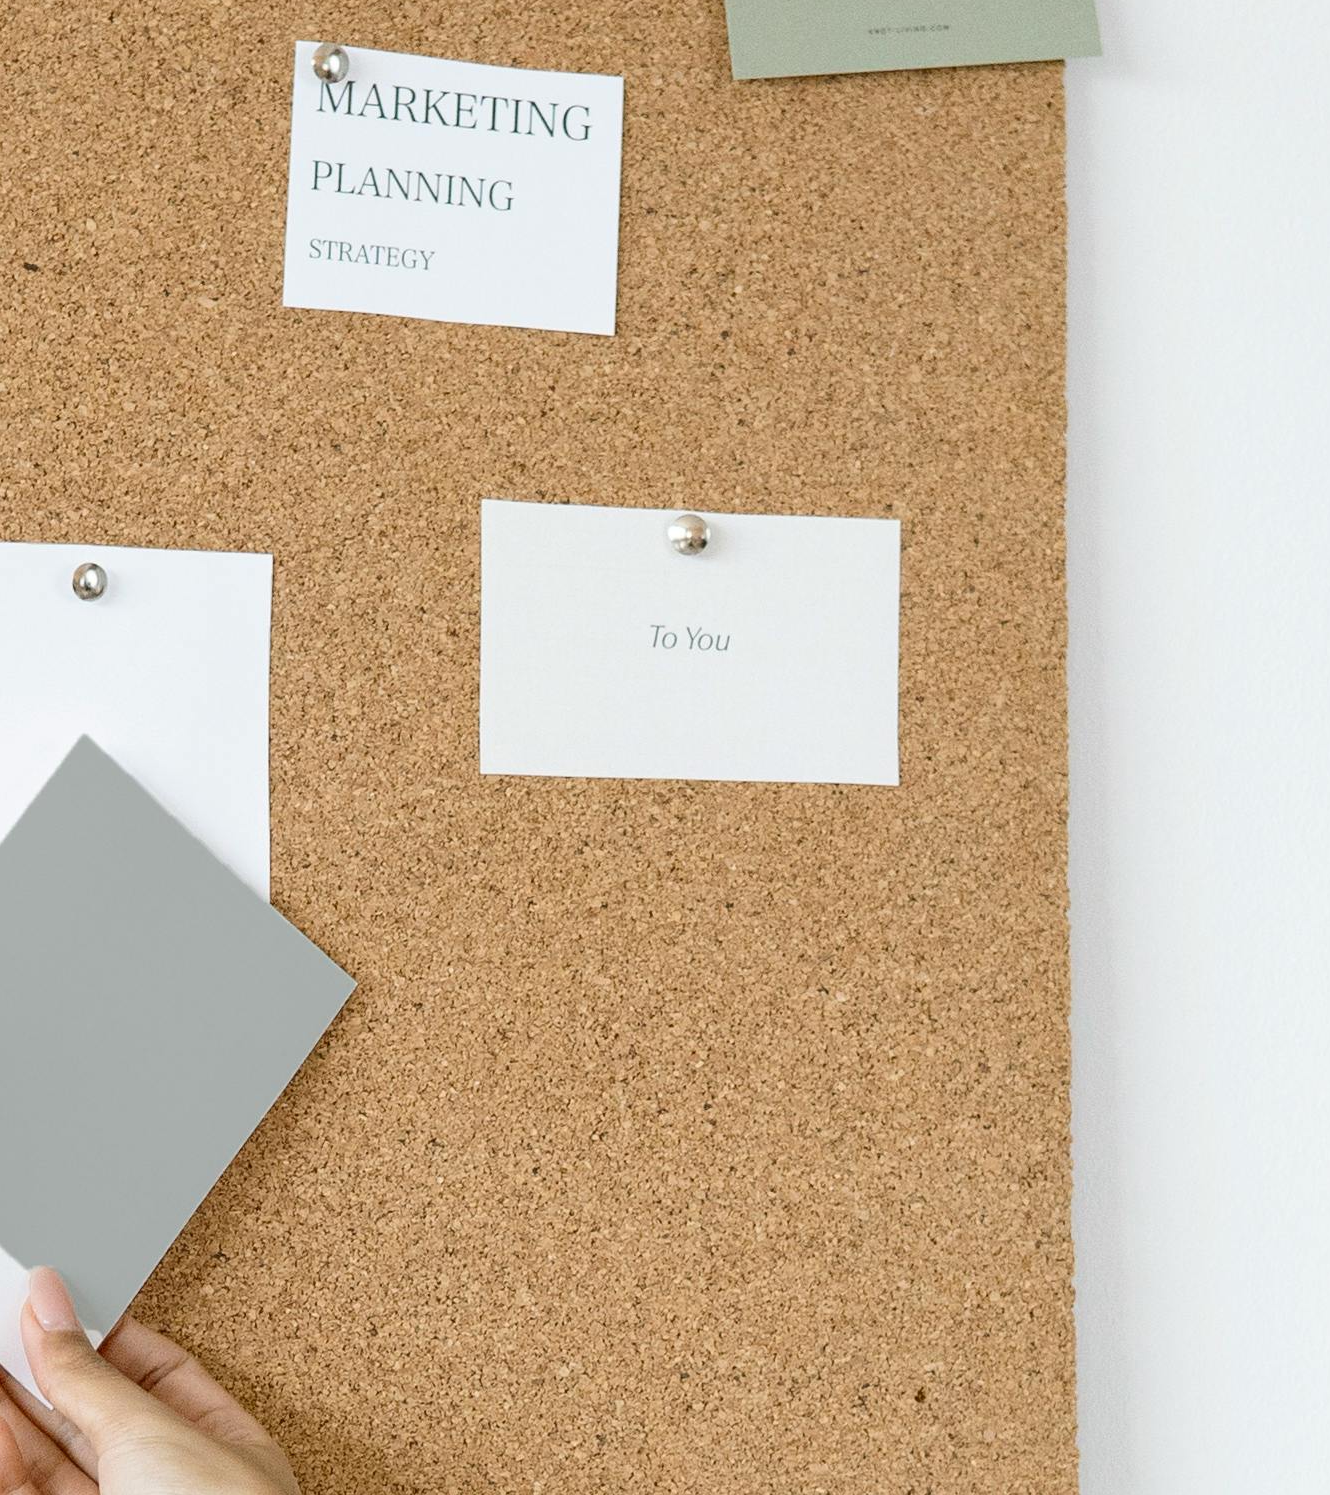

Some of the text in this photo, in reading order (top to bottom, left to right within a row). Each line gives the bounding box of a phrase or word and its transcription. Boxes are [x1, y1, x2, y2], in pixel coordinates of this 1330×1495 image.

[316, 80, 593, 142] MARKETING
[310, 159, 514, 212] PLANNING
[308, 238, 436, 272] STRATEGY
[650, 624, 731, 652] To You
